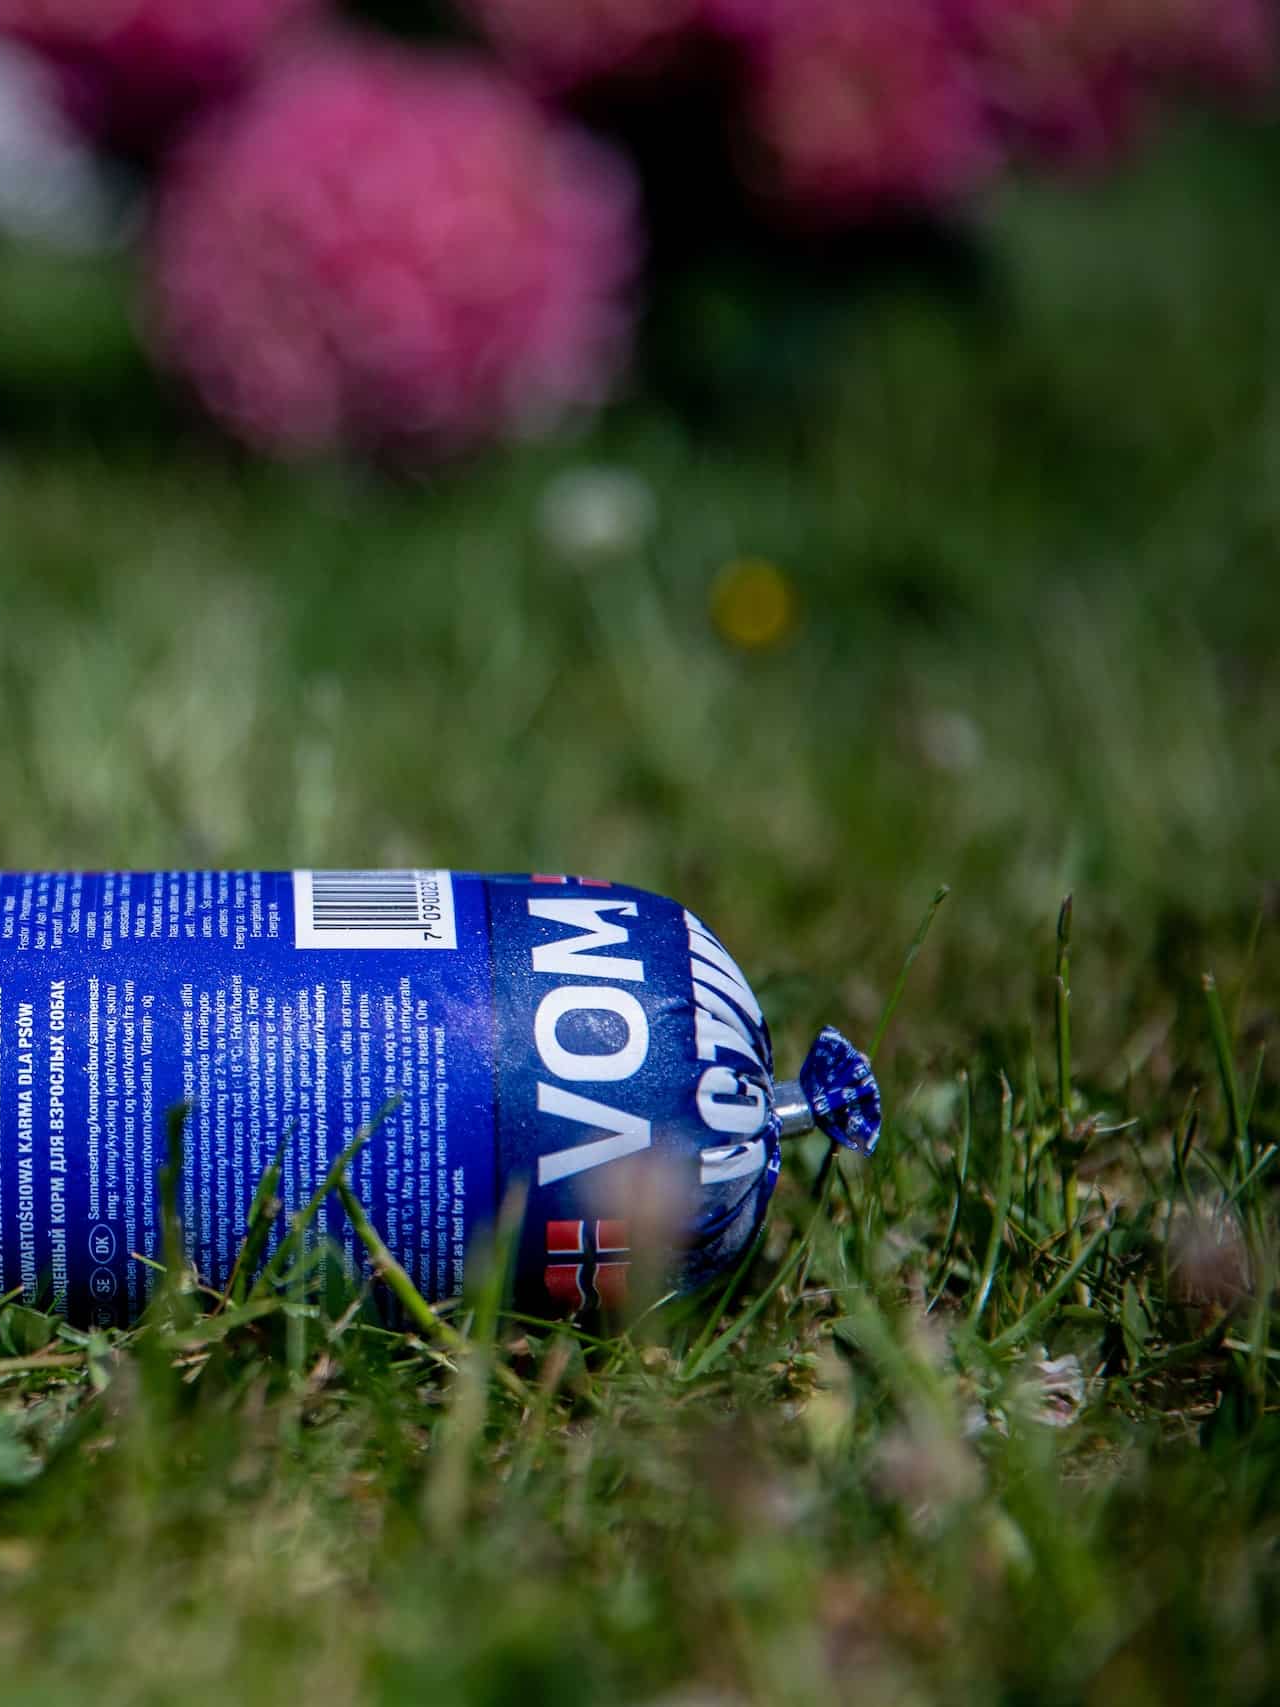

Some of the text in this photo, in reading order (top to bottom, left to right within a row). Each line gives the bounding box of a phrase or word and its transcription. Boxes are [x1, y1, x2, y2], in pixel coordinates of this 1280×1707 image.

[423, 931, 442, 941] 7
[51, 980, 66, 1031] СОБАК
[415, 1000, 429, 1021] One
[527, 897, 652, 1186] VOM
[18, 1053, 33, 1086] DLA
[382, 1065, 396, 1084] the
[399, 1059, 415, 1087] days
[435, 1058, 447, 1079] raw
[50, 1036, 65, 1130] ВЗРОСЛЫХ
[358, 1076, 371, 1098] and
[18, 1090, 33, 1152] KARMA
[341, 1101, 353, 1124] and
[418, 1098, 430, 1126] been
[418, 1130, 430, 1148] not
[434, 1135, 448, 1166] when
[50, 1135, 68, 1173] ДЛЯ
[383, 1140, 397, 1166] food
[419, 1150, 431, 1171] has
[384, 1168, 399, 1190] dog
[50, 1177, 67, 1223] КОРМ
[450, 1198, 464, 1214] for
[450, 1217, 464, 1241] feed
[94, 1236, 110, 1254] DK
